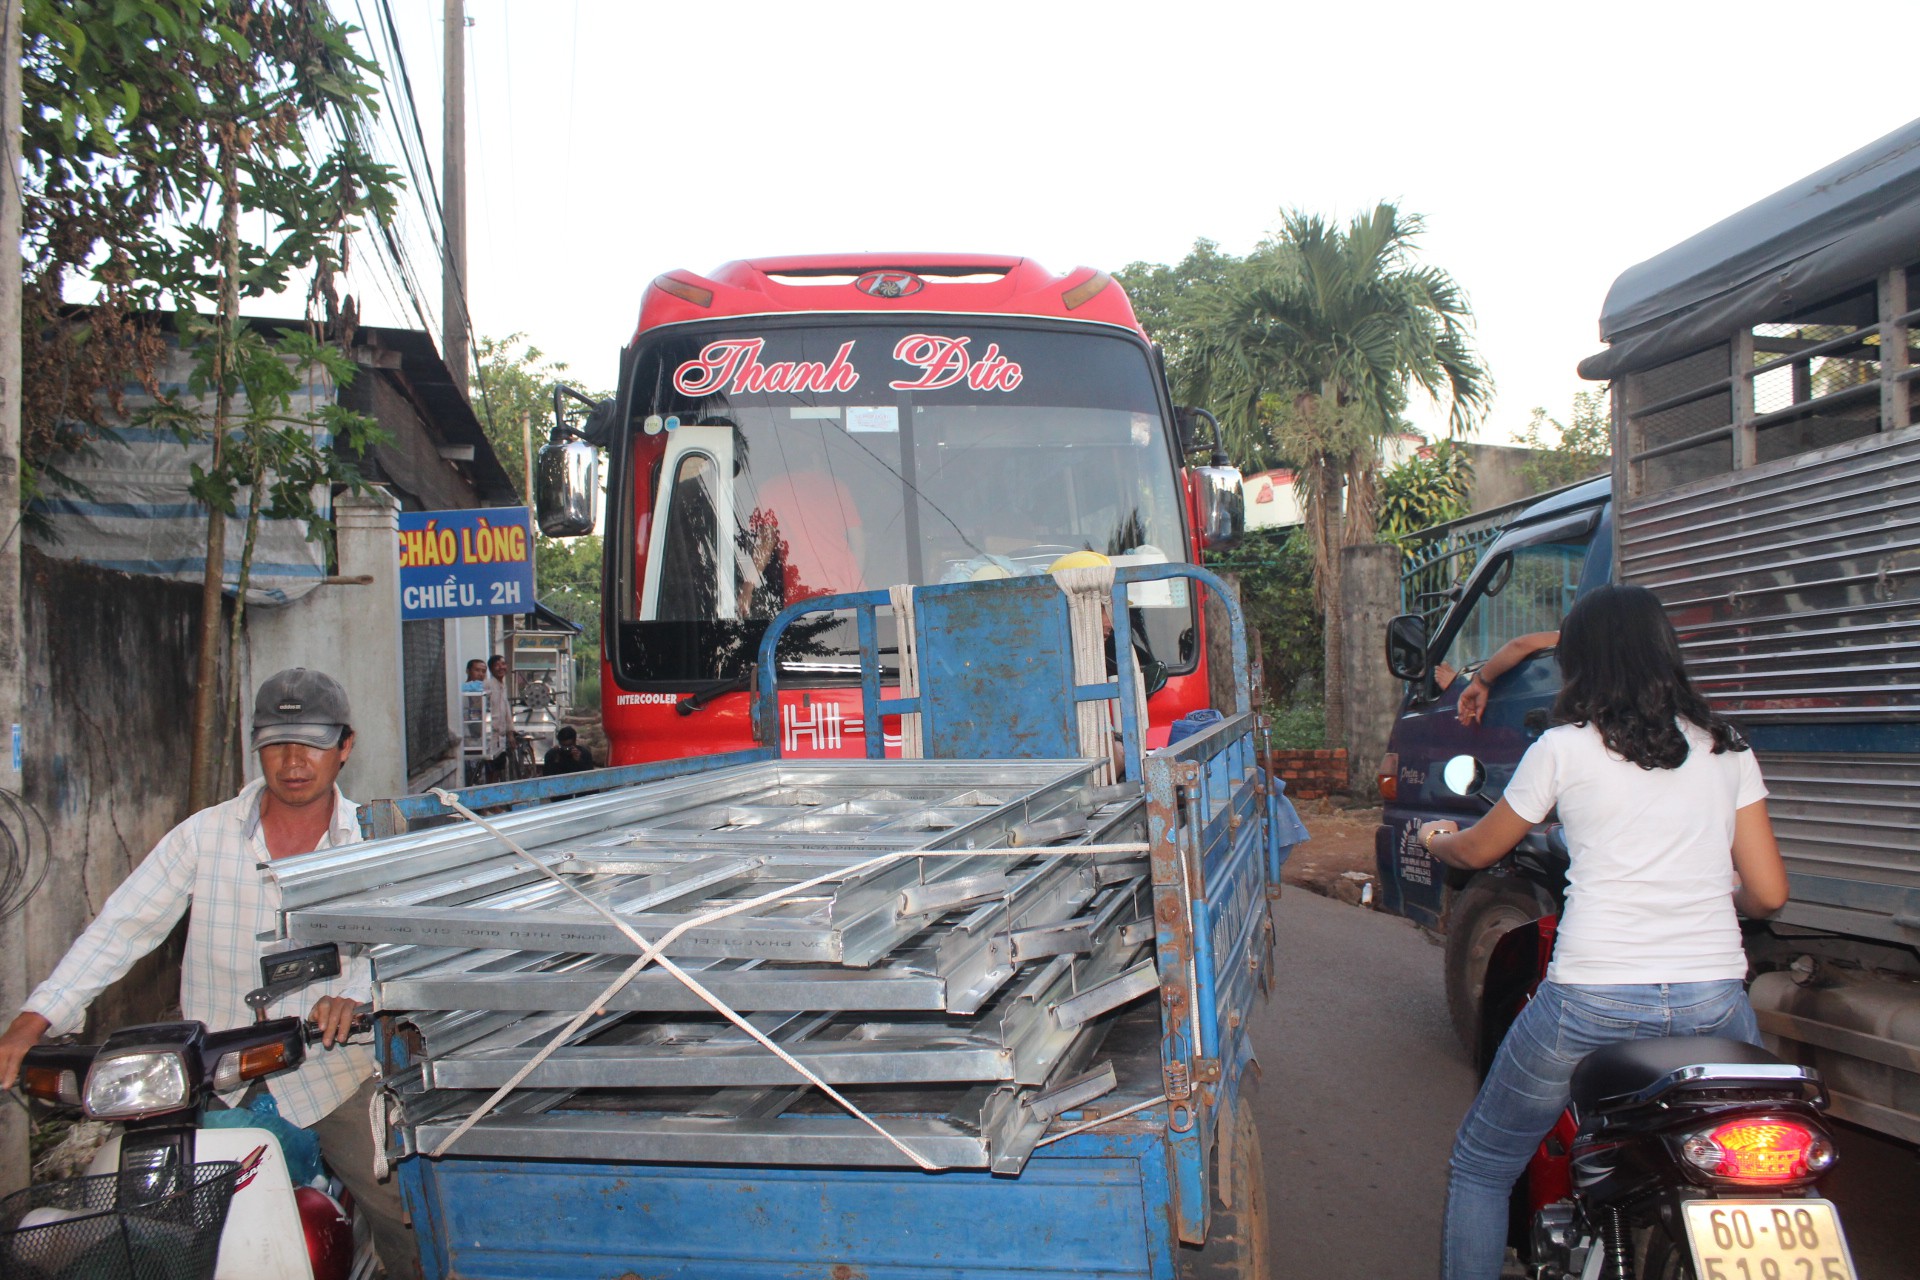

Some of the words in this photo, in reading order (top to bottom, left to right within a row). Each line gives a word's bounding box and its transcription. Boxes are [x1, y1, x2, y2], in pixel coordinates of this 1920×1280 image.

[673, 337, 859, 396] Thanh
[889, 334, 1023, 392] Đức
[398, 519, 458, 567] CHÁO
[461, 517, 528, 564] LÒNG
[490, 581, 521, 605] 2H
[617, 693, 677, 705] INTERCOOLER
[1709, 1208, 1819, 1250] 60-B8
